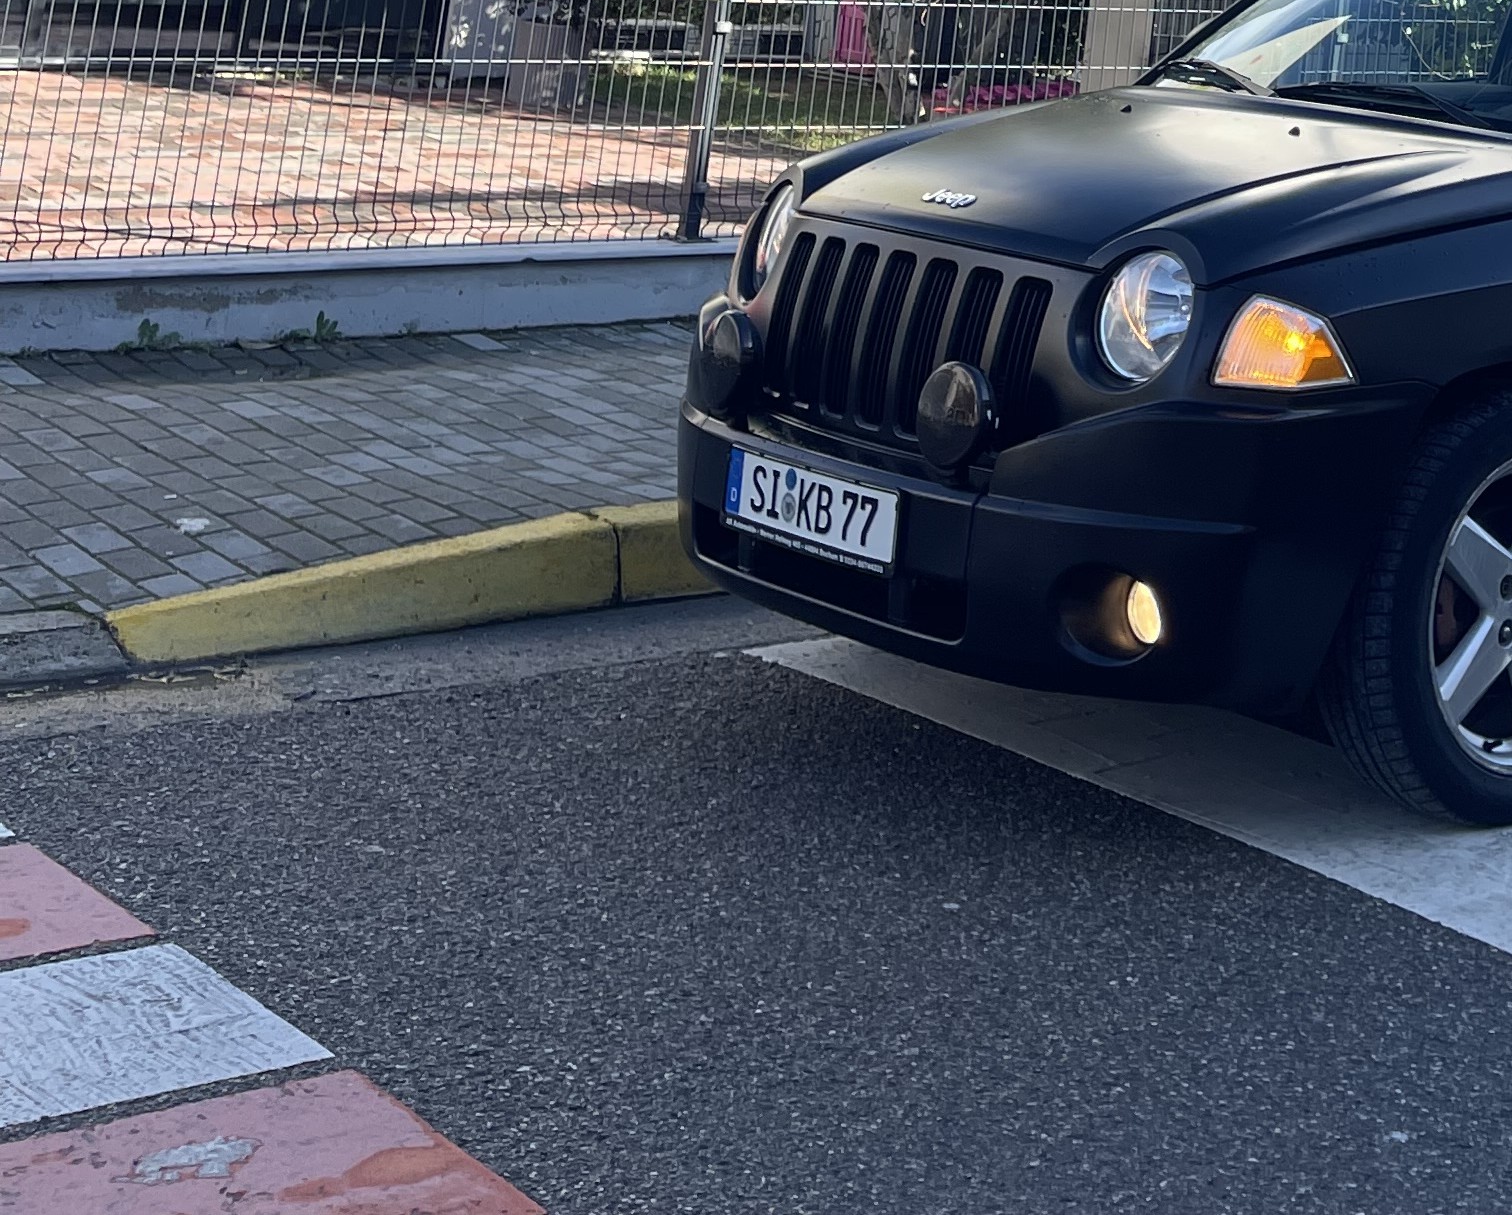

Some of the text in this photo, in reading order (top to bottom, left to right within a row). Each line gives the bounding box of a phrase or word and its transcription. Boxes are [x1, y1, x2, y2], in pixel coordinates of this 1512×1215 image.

[921, 188, 977, 208] Jeep
[730, 486, 738, 502] D
[750, 465, 781, 520] SI
[796, 478, 833, 534] KB
[842, 490, 879, 547] 77
